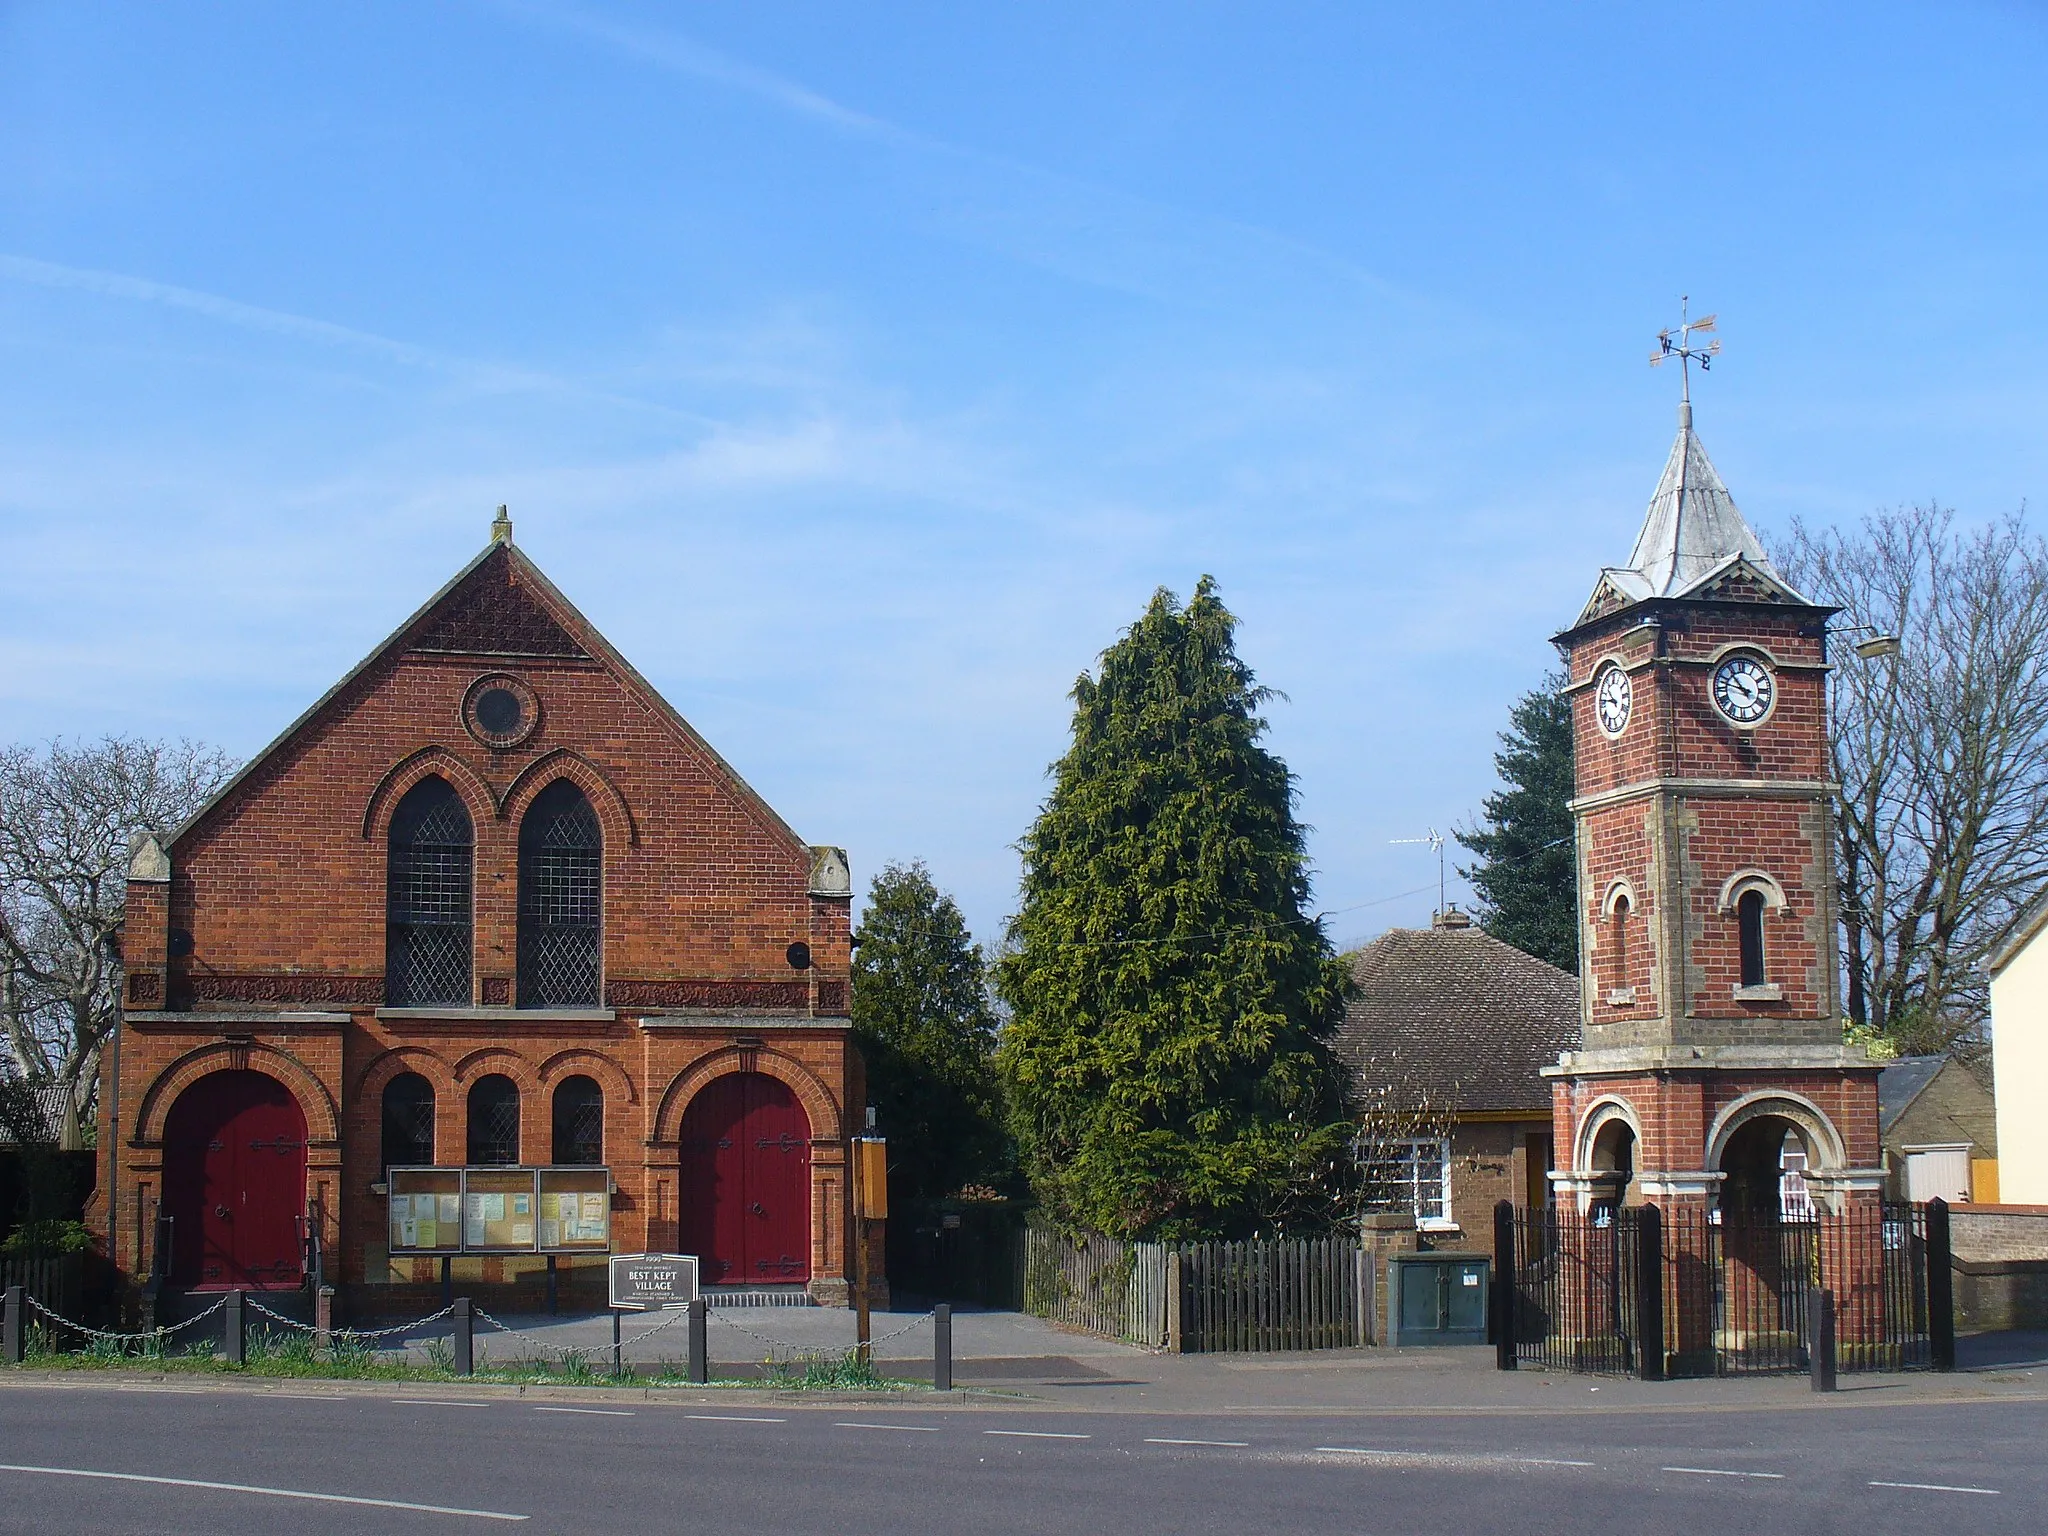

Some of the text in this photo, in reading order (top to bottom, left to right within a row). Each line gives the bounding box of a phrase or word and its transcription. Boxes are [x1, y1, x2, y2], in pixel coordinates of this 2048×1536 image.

[1701, 353, 1711, 371] E
[629, 1271, 677, 1280] BEST KEPT
[635, 1281, 672, 1290] VILLAGE
